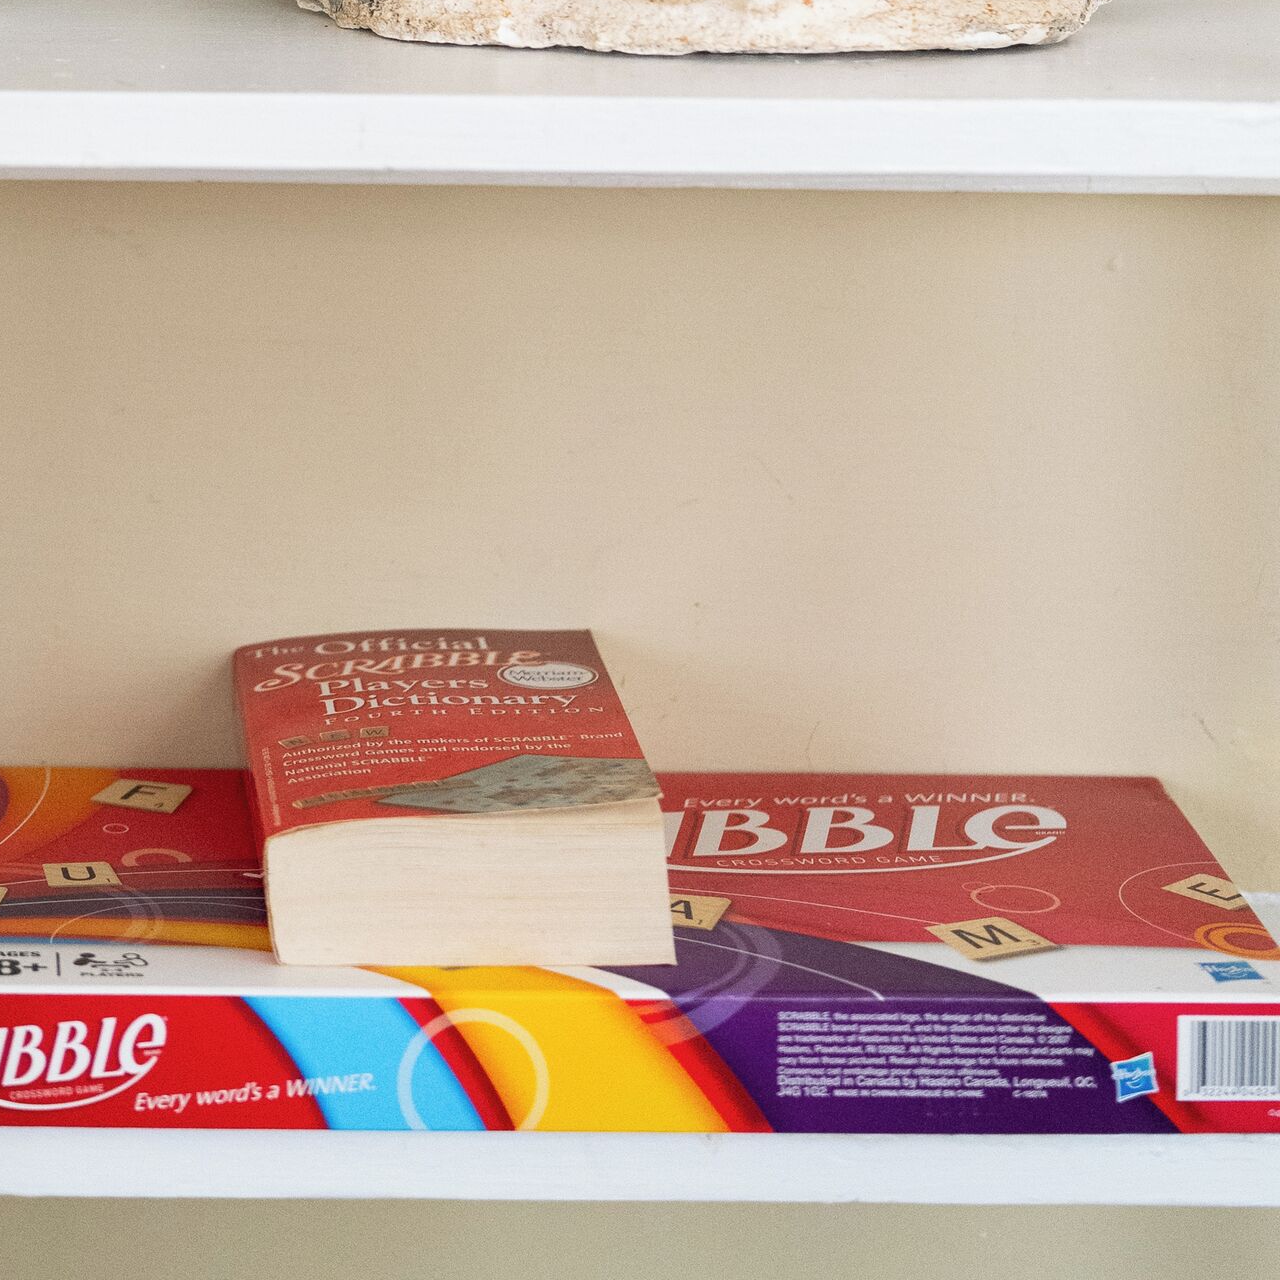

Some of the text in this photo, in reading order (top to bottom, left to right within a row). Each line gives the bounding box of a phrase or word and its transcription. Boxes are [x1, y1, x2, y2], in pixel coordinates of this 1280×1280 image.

[247, 635, 489, 660] The Official
[319, 677, 489, 697] Players
[321, 692, 578, 716] Dictionary
[325, 706, 605, 726] FOURTH EDITION
[282, 742, 361, 759] Authorized
[366, 740, 384, 749] by
[388, 738, 412, 746] the
[580, 731, 624, 740] Brand
[282, 750, 360, 767] Crossword
[365, 747, 415, 756] Games
[419, 745, 447, 753] and
[452, 744, 520, 752] endorsed
[525, 743, 543, 751] by
[284, 760, 347, 777] National
[287, 767, 372, 785] Association
[684, 791, 1035, 809] Every word's a WINNER.
[716, 854, 944, 869] CROSSWORD GAME
[60, 865, 96, 881] U
[950, 923, 1022, 949] M
[9, 1082, 105, 1101] CROSSWORD GAME
[134, 1072, 378, 1114] Every word's a WINNER.
